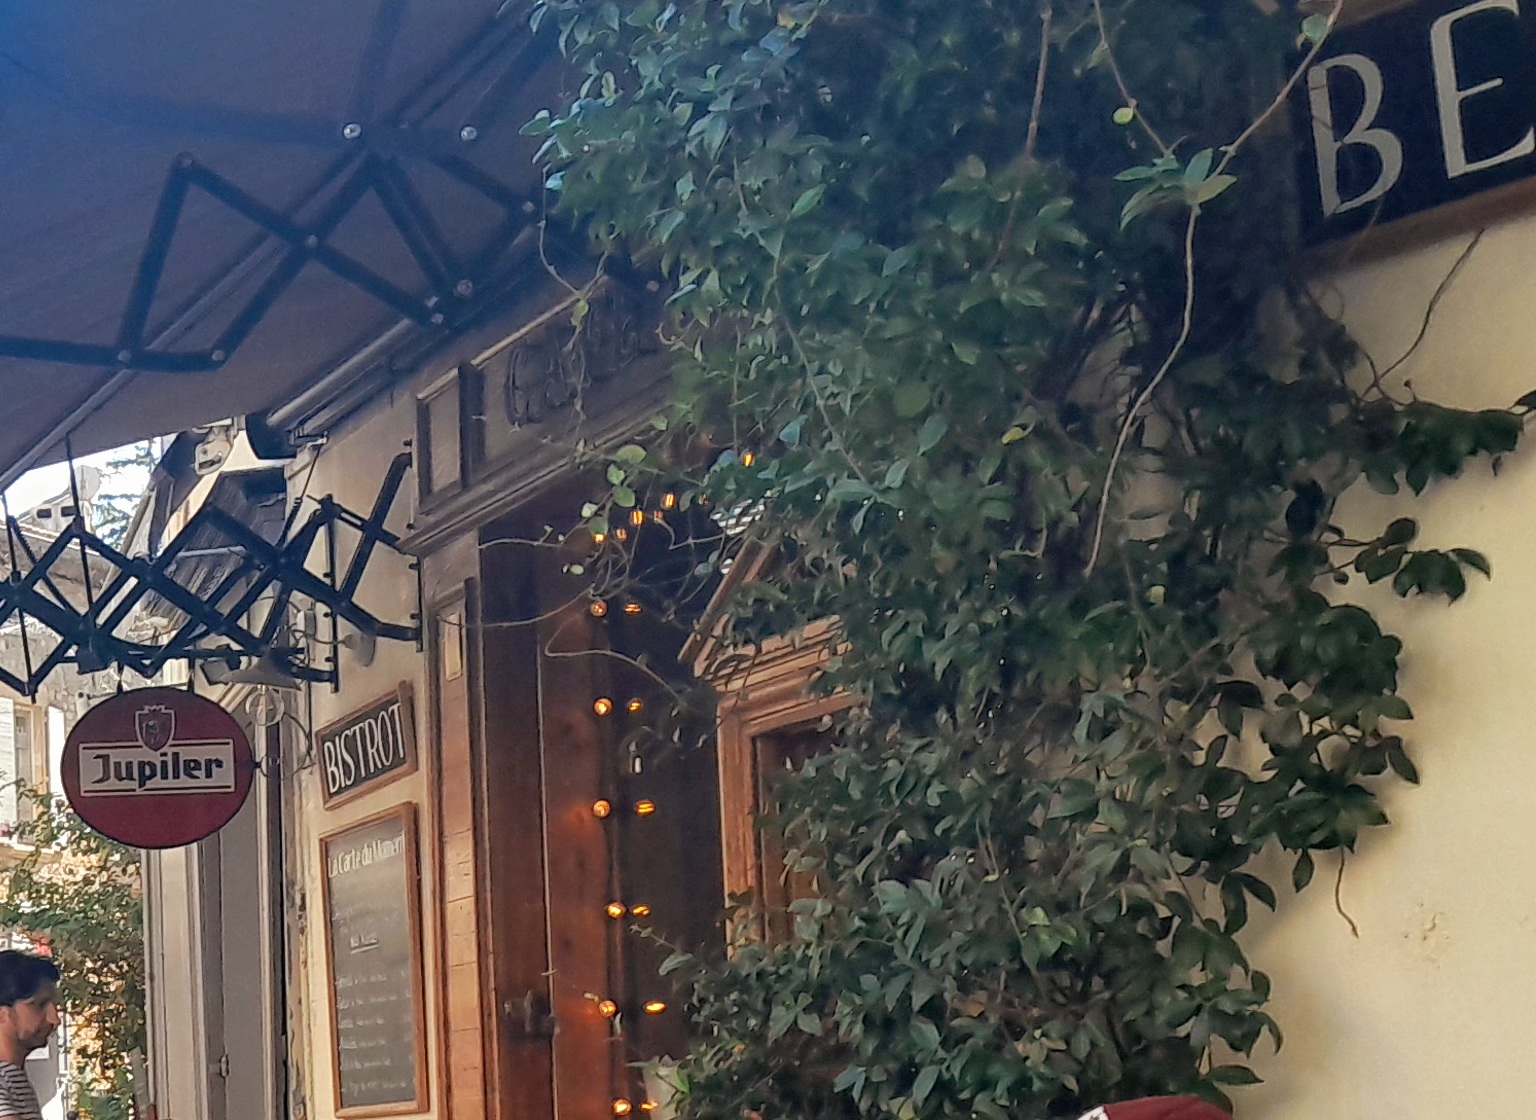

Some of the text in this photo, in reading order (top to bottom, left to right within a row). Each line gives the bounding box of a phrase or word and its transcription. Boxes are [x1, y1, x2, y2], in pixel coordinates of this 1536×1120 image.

[1307, 0, 1536, 217] BE
[91, 751, 224, 789] Jupiler
[323, 702, 405, 794] BISTROT
